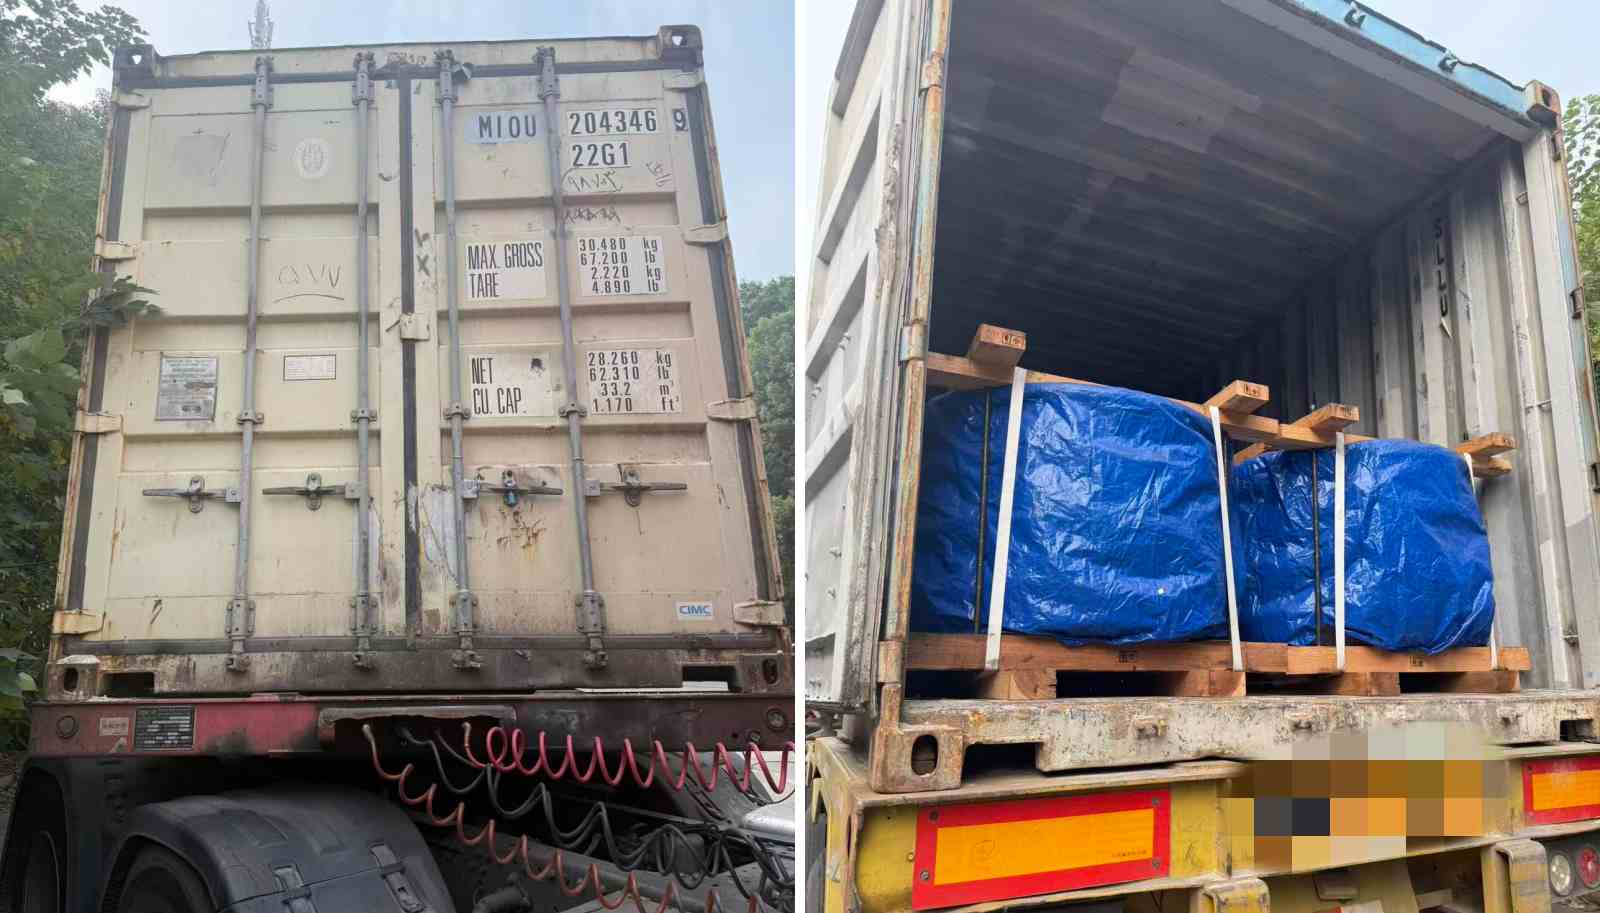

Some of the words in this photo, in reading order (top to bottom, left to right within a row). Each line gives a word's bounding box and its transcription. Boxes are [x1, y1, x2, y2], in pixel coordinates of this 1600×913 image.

[479, 115, 537, 138] MIOU
[569, 110, 657, 135] 204346
[673, 110, 687, 131] 9
[571, 142, 630, 167] 22G1
[579, 237, 627, 251] 30.480
[643, 237, 659, 252] kg
[468, 244, 501, 269] MAX.
[504, 242, 544, 268] GROSS
[580, 252, 628, 266] 67.200
[644, 252, 656, 264] lb
[591, 266, 630, 280] 2.220
[646, 266, 661, 281] kg
[469, 273, 500, 298] TARE
[592, 280, 631, 294] 4.890
[647, 280, 659, 293] lb
[588, 351, 639, 366] 28.260
[656, 351, 672, 367] kg
[471, 358, 494, 385] NET
[589, 366, 640, 381] 62.310
[656, 366, 670, 380] lb
[600, 383, 632, 397] 33.2
[473, 390, 494, 415] CU.
[497, 388, 527, 414] CAP.
[593, 398, 633, 412] 1.170
[679, 605, 713, 615] CIMC
